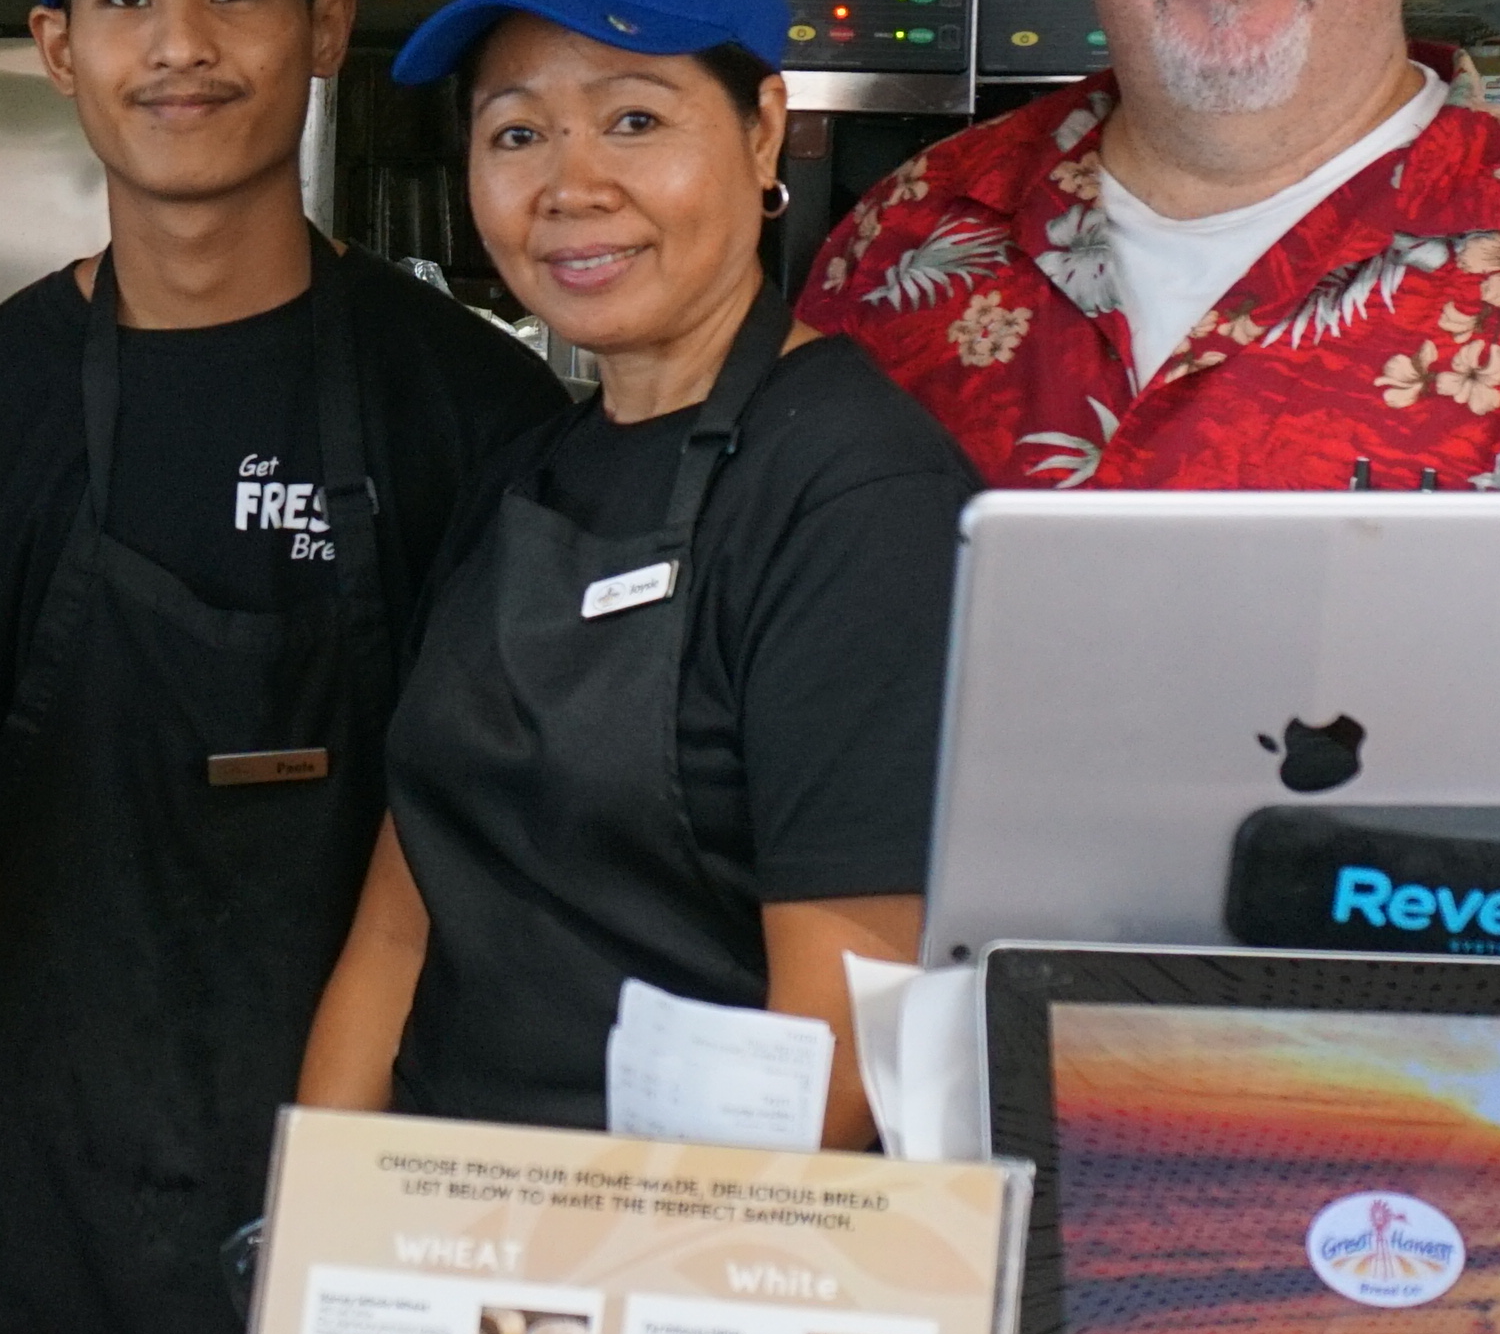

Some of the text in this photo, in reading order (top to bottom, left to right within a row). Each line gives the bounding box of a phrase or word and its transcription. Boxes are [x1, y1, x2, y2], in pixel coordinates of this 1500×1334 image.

[238, 453, 279, 478] Get
[234, 481, 331, 533] FRES
[290, 535, 336, 562] Bre
[377, 1152, 460, 1177] CHOOSE
[465, 1161, 521, 1184] FROM
[526, 1165, 570, 1187] OUR
[710, 1181, 818, 1208] DELICIOUS
[822, 1190, 891, 1213] BREAD
[403, 1179, 857, 1234] LIST BELOW TO MAKE THE PERFECT SANDWICH.
[393, 1233, 524, 1273] WHEAT
[725, 1261, 840, 1304] White
